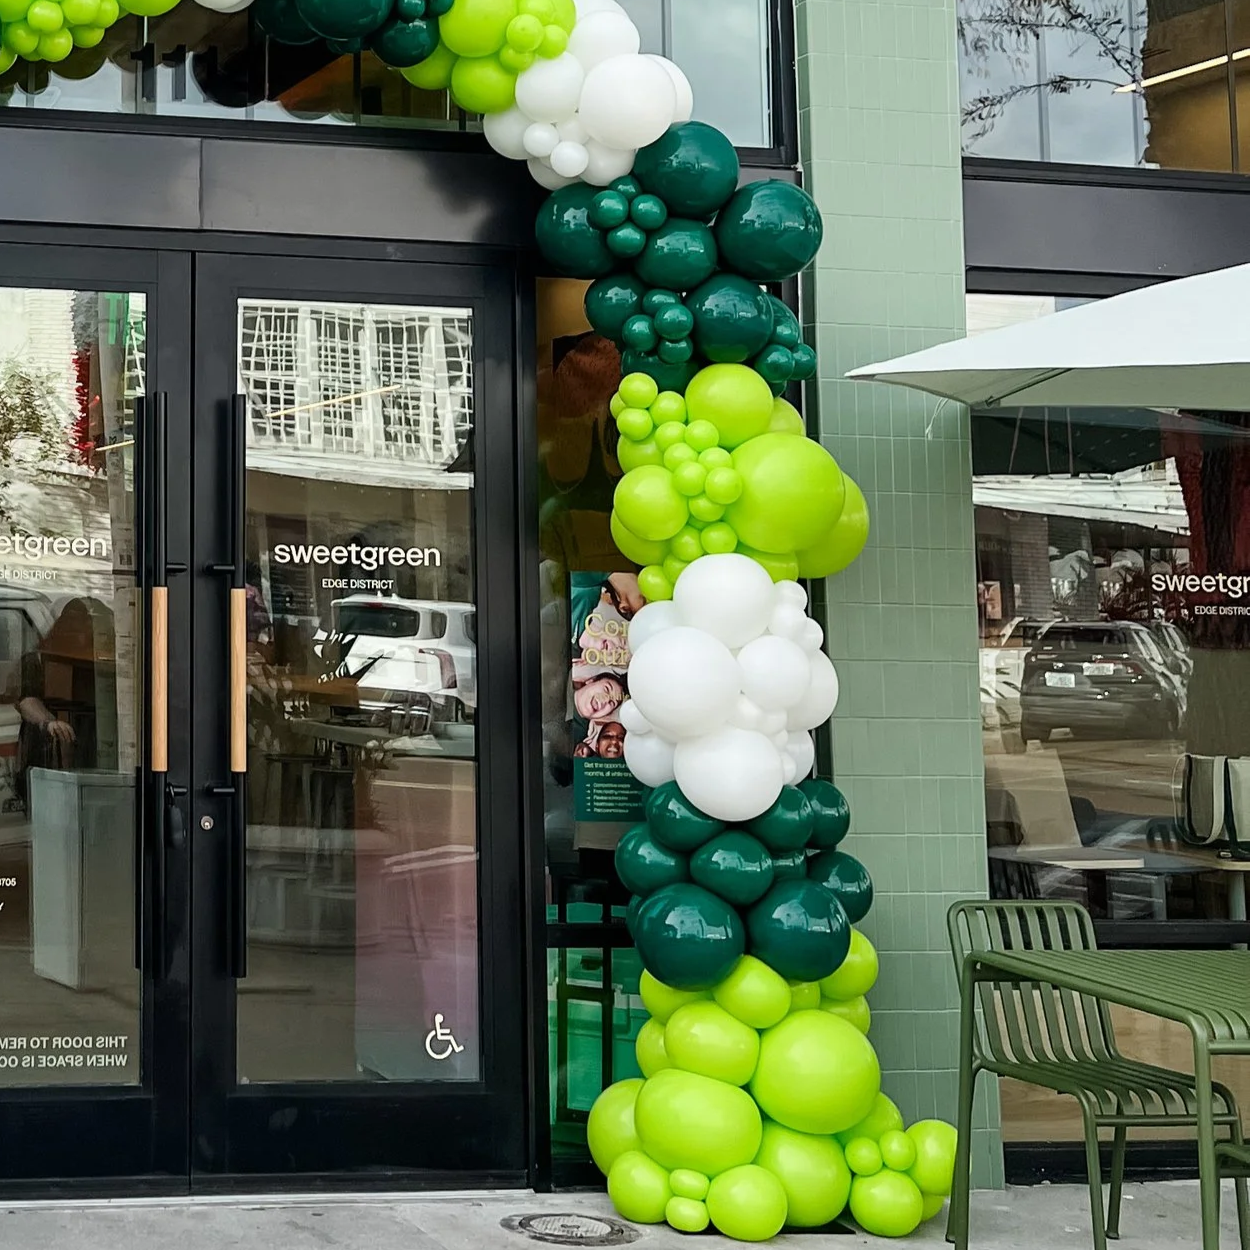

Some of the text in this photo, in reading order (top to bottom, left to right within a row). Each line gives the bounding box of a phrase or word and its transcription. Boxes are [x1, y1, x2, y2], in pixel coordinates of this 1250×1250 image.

[274, 543, 441, 571] sweetgreen
[13, 570, 58, 580] DISTRICT
[322, 579, 394, 589] EDGE DISTRICT
[1194, 606, 1217, 615] EDGE
